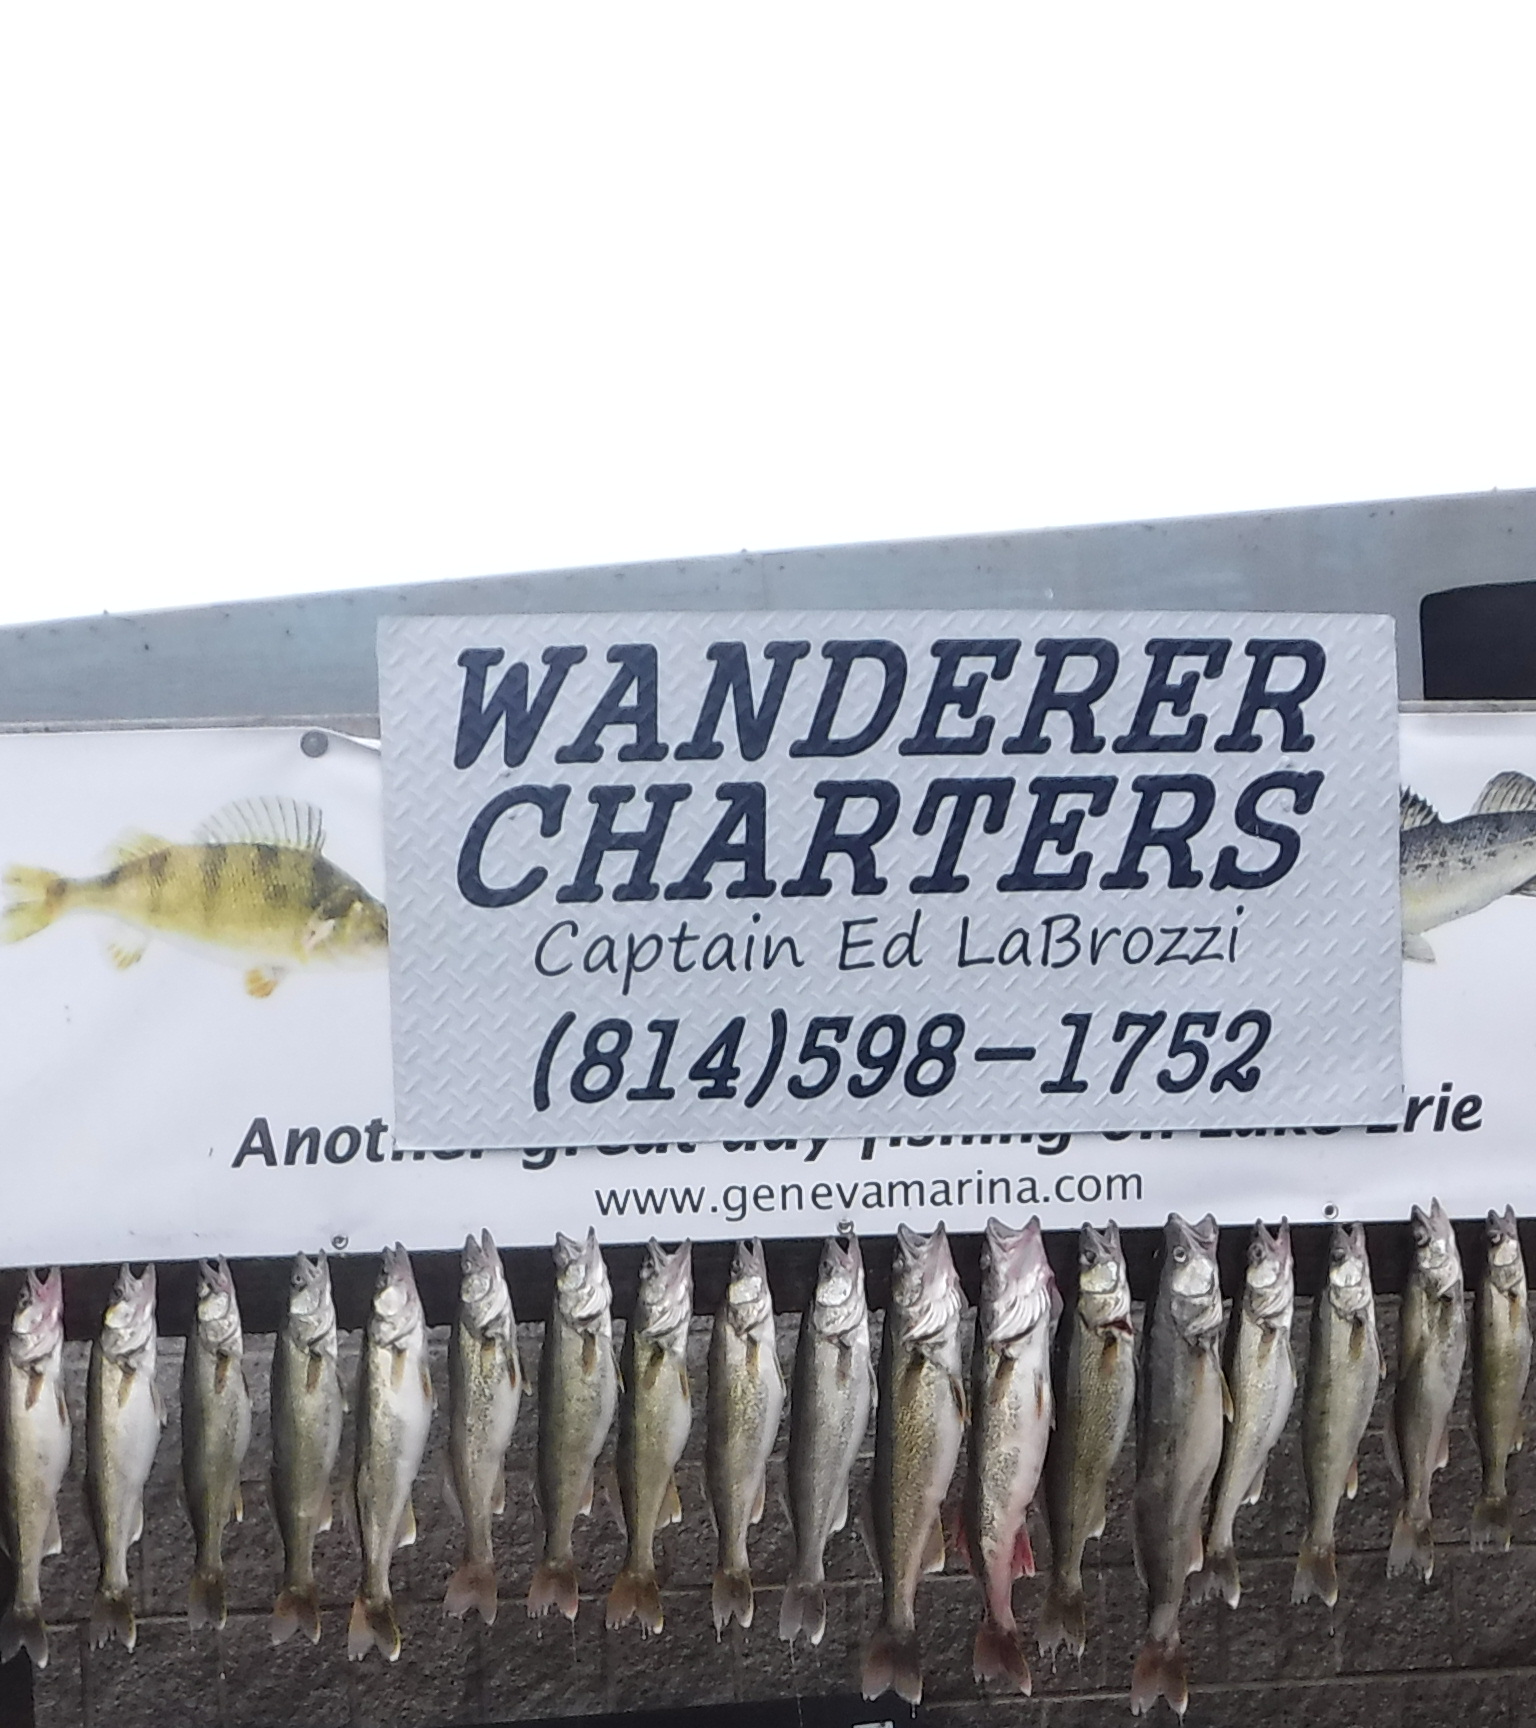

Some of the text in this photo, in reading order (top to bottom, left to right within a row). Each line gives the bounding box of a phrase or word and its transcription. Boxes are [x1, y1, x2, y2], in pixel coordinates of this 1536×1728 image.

[452, 637, 1328, 771] WANDERER
[456, 770, 1321, 908] CHARTERS
[533, 905, 1240, 996] Captain Ed LaBrozzi
[532, 1009, 1274, 1113] (814)598-1752
[231, 1116, 486, 1170] Anot
[1366, 1082, 1484, 1135] rie
[594, 1168, 1145, 1223] www.genevamarina.com
